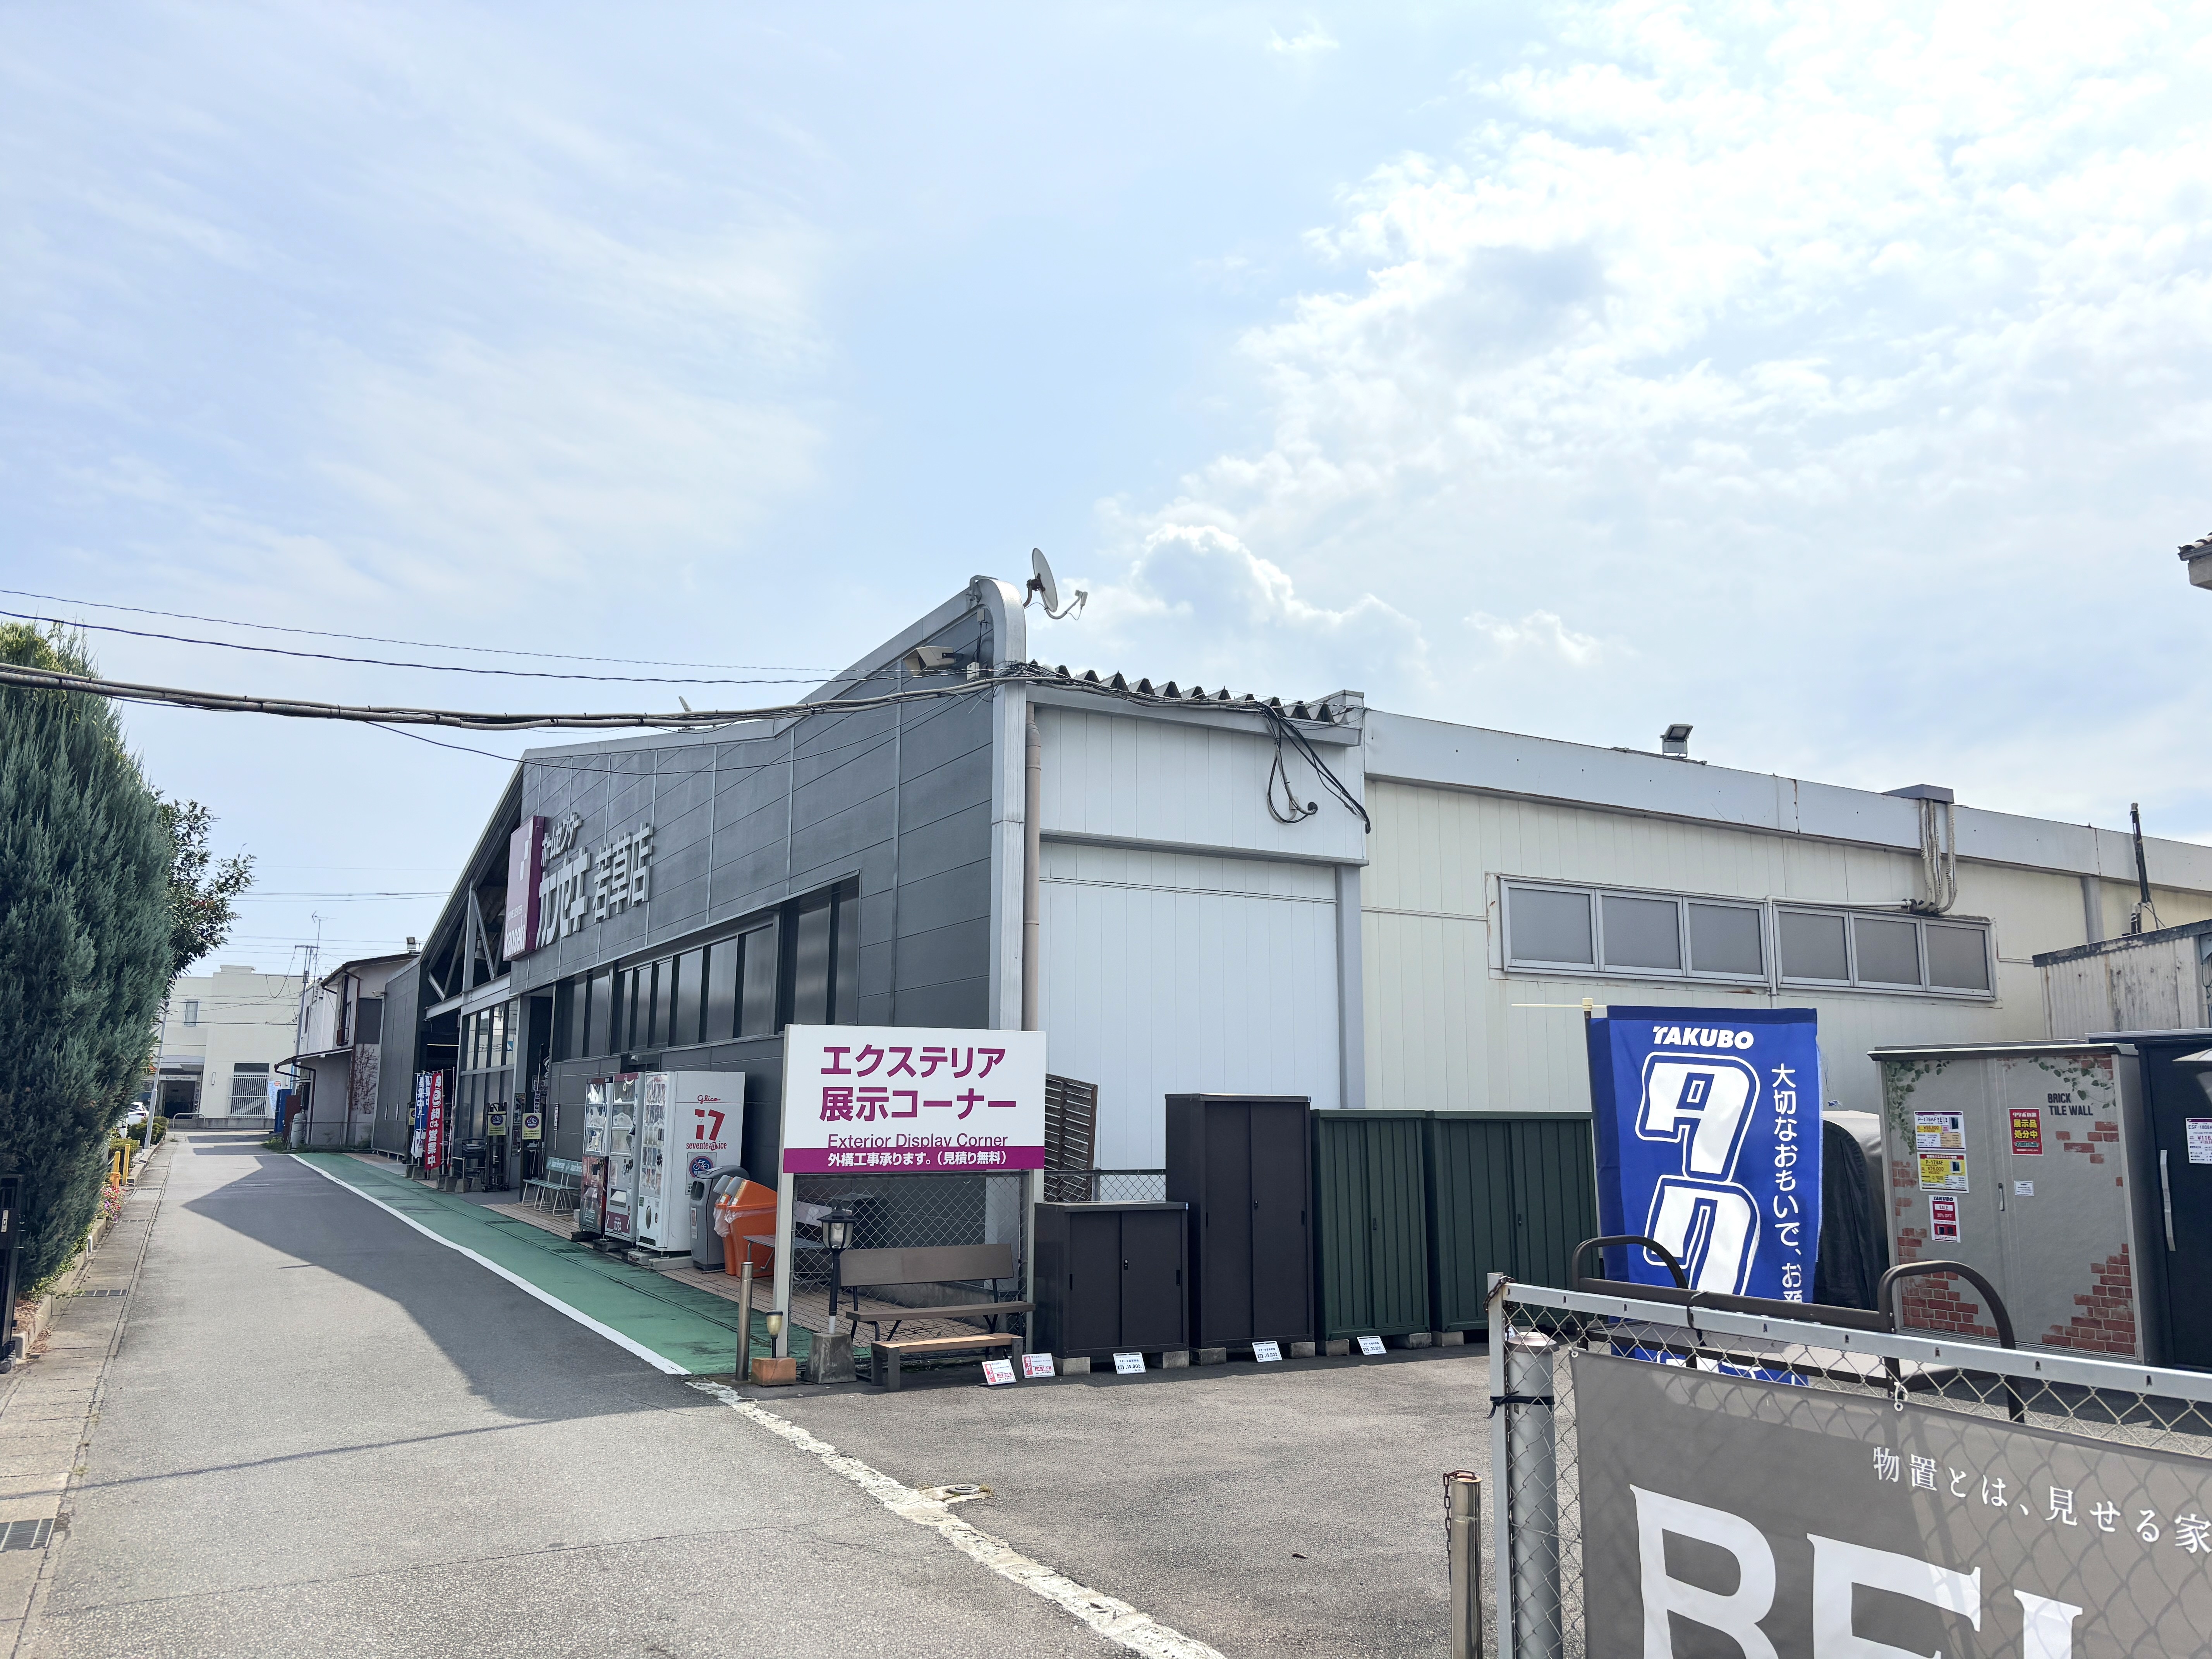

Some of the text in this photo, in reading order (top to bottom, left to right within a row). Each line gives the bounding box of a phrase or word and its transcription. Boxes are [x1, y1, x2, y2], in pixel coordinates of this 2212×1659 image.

[592, 823, 653, 923] 若草店
[504, 913, 526, 958] kanseki
[1653, 1026, 1754, 1049] TAKUBO
[821, 1044, 1006, 1078] エクステリア
[697, 1095, 721, 1104] Glico
[819, 1087, 1016, 1121] 展示コーナー
[2047, 1093, 2071, 1103] BRICK
[2048, 1105, 2093, 1115] TILE WALL
[686, 1140, 727, 1151] seventeen ice
[828, 1133, 1008, 1148] Exterior Display Corner
[1873, 1446, 2212, 1553] 物置とは、見せる家
